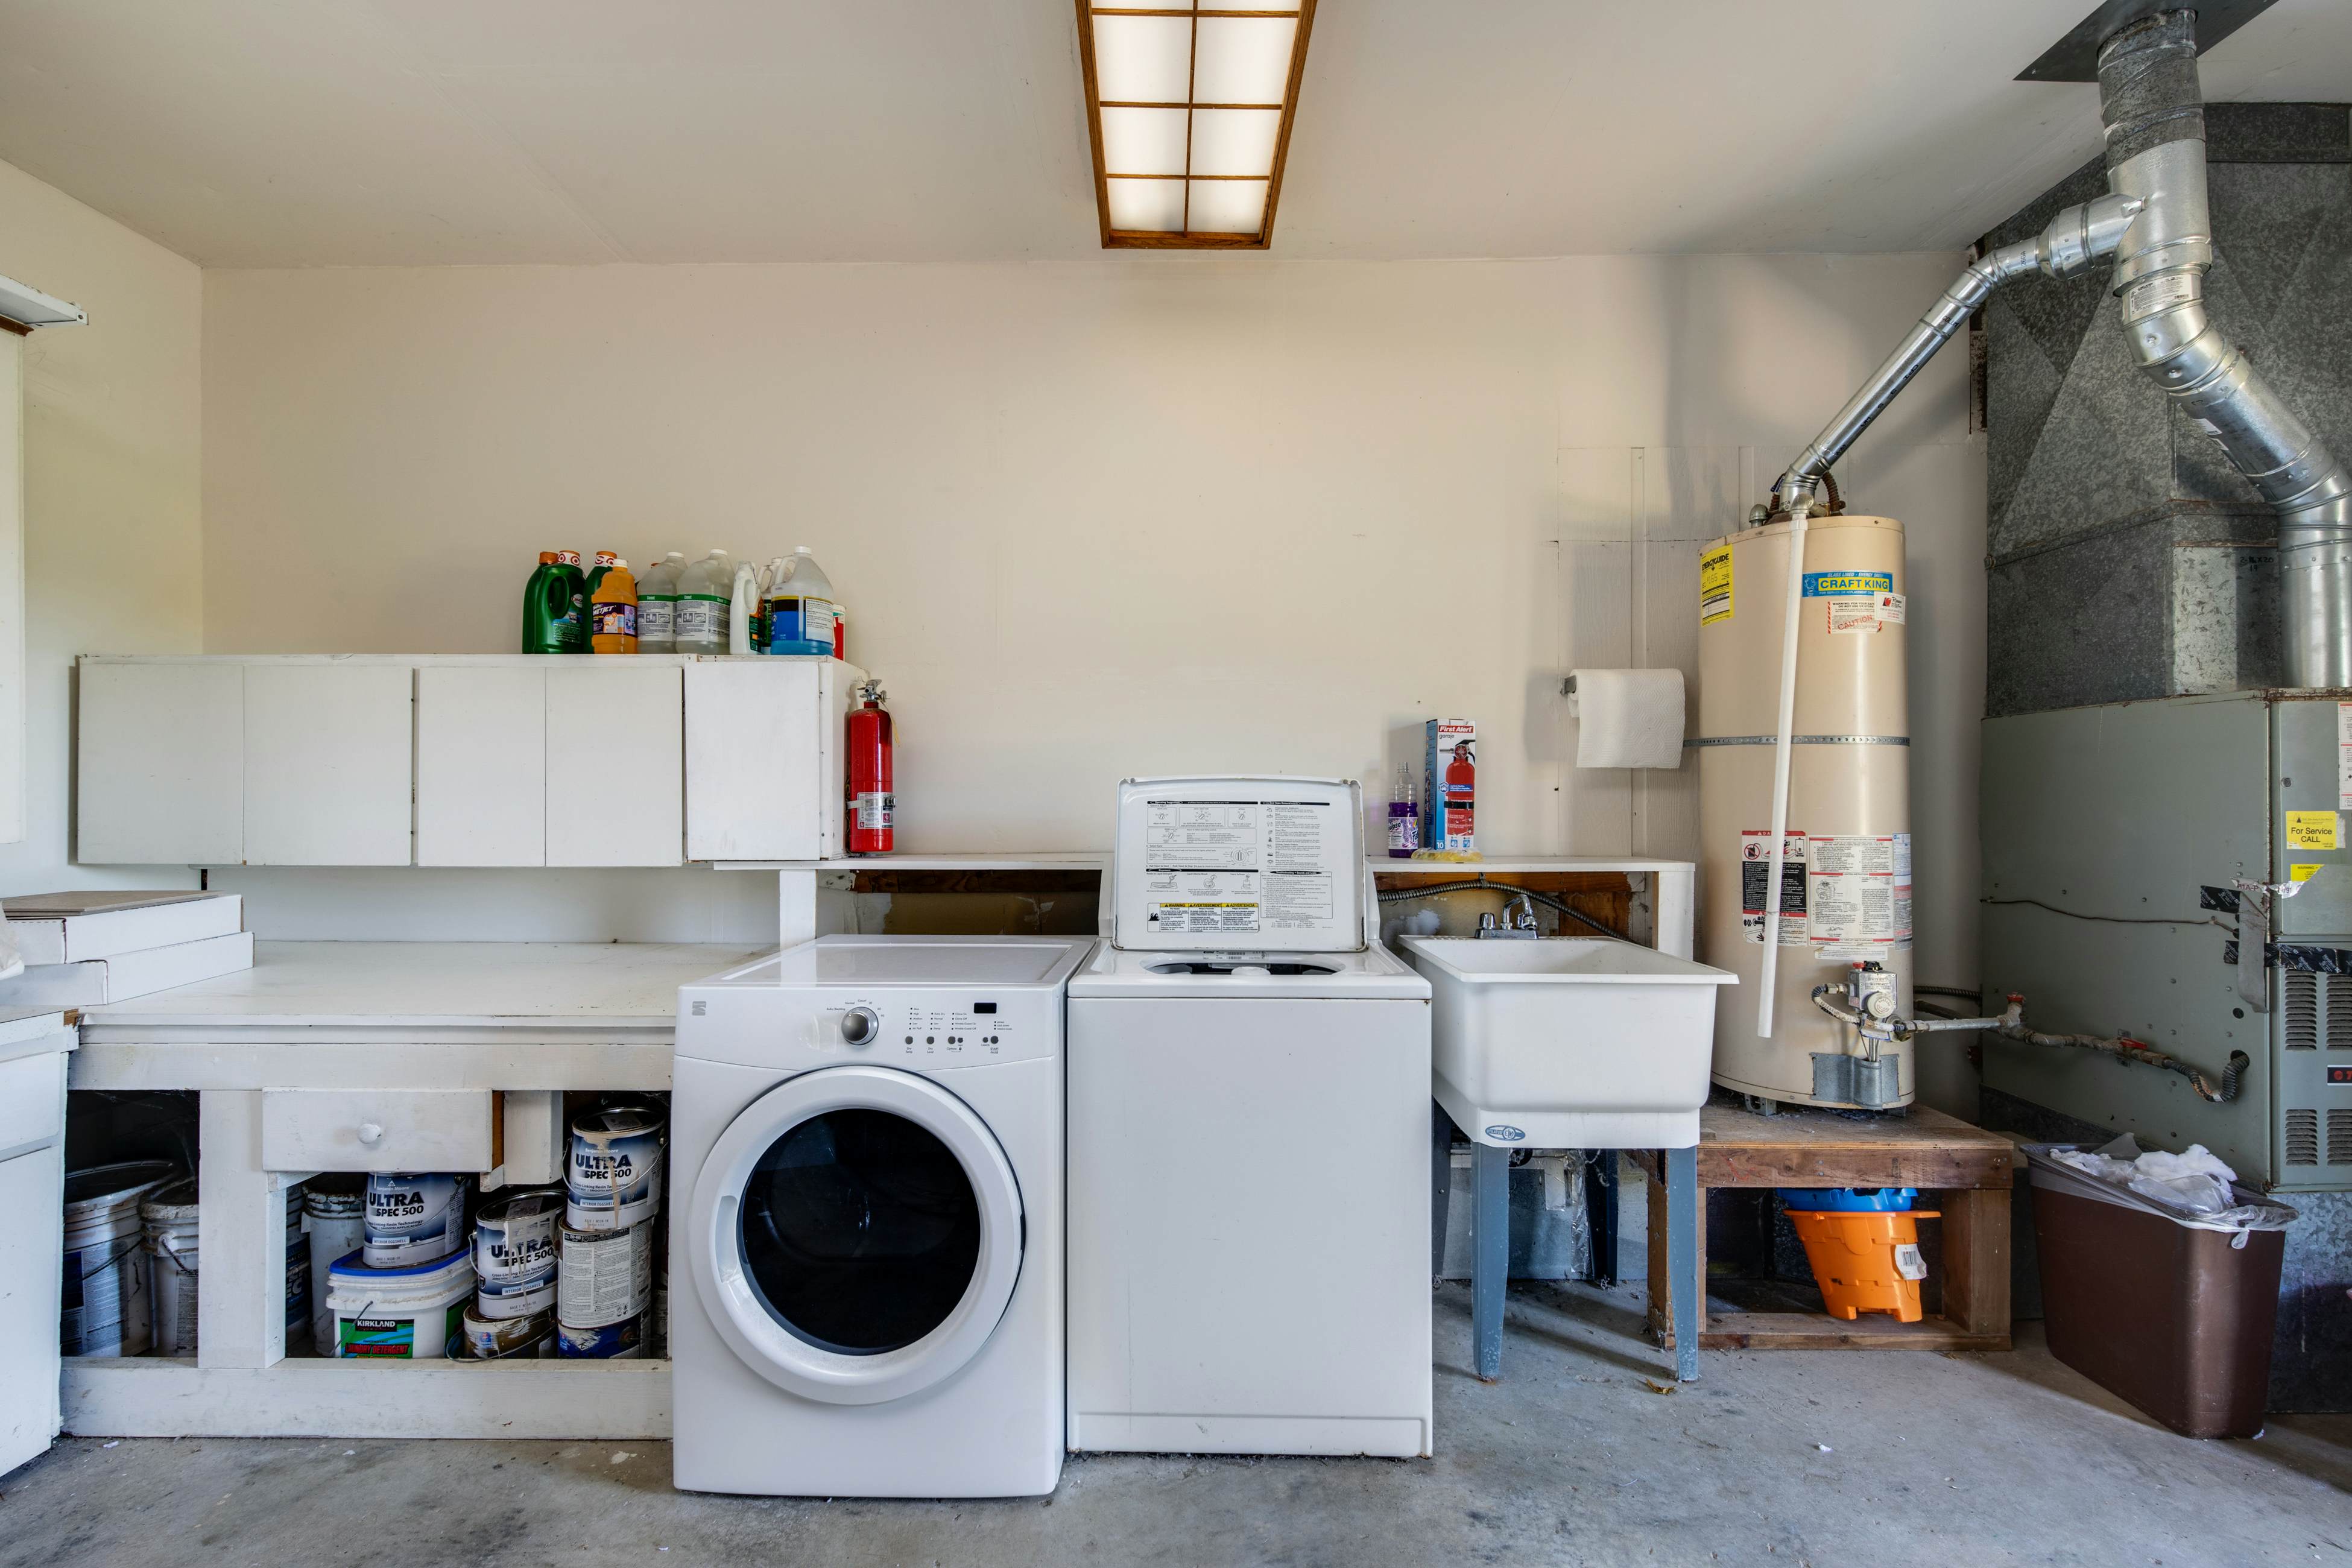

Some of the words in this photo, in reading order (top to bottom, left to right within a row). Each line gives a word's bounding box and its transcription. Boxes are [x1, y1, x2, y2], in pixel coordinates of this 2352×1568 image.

[1820, 579, 1862, 589] CRAFT
[1865, 580, 1888, 589] KING
[1838, 615, 1873, 630] CAUTION
[576, 1153, 632, 1169] ULTRA
[585, 1171, 609, 1179] SPEC
[369, 1191, 425, 1207] ULTRA
[376, 1208, 399, 1217] SPEC
[402, 1205, 424, 1216] 500
[535, 1247, 553, 1261] 500
[522, 1283, 541, 1291] GGSHELL
[346, 1344, 371, 1355] LAUNDRY
[372, 1344, 409, 1355] DETERGENT
